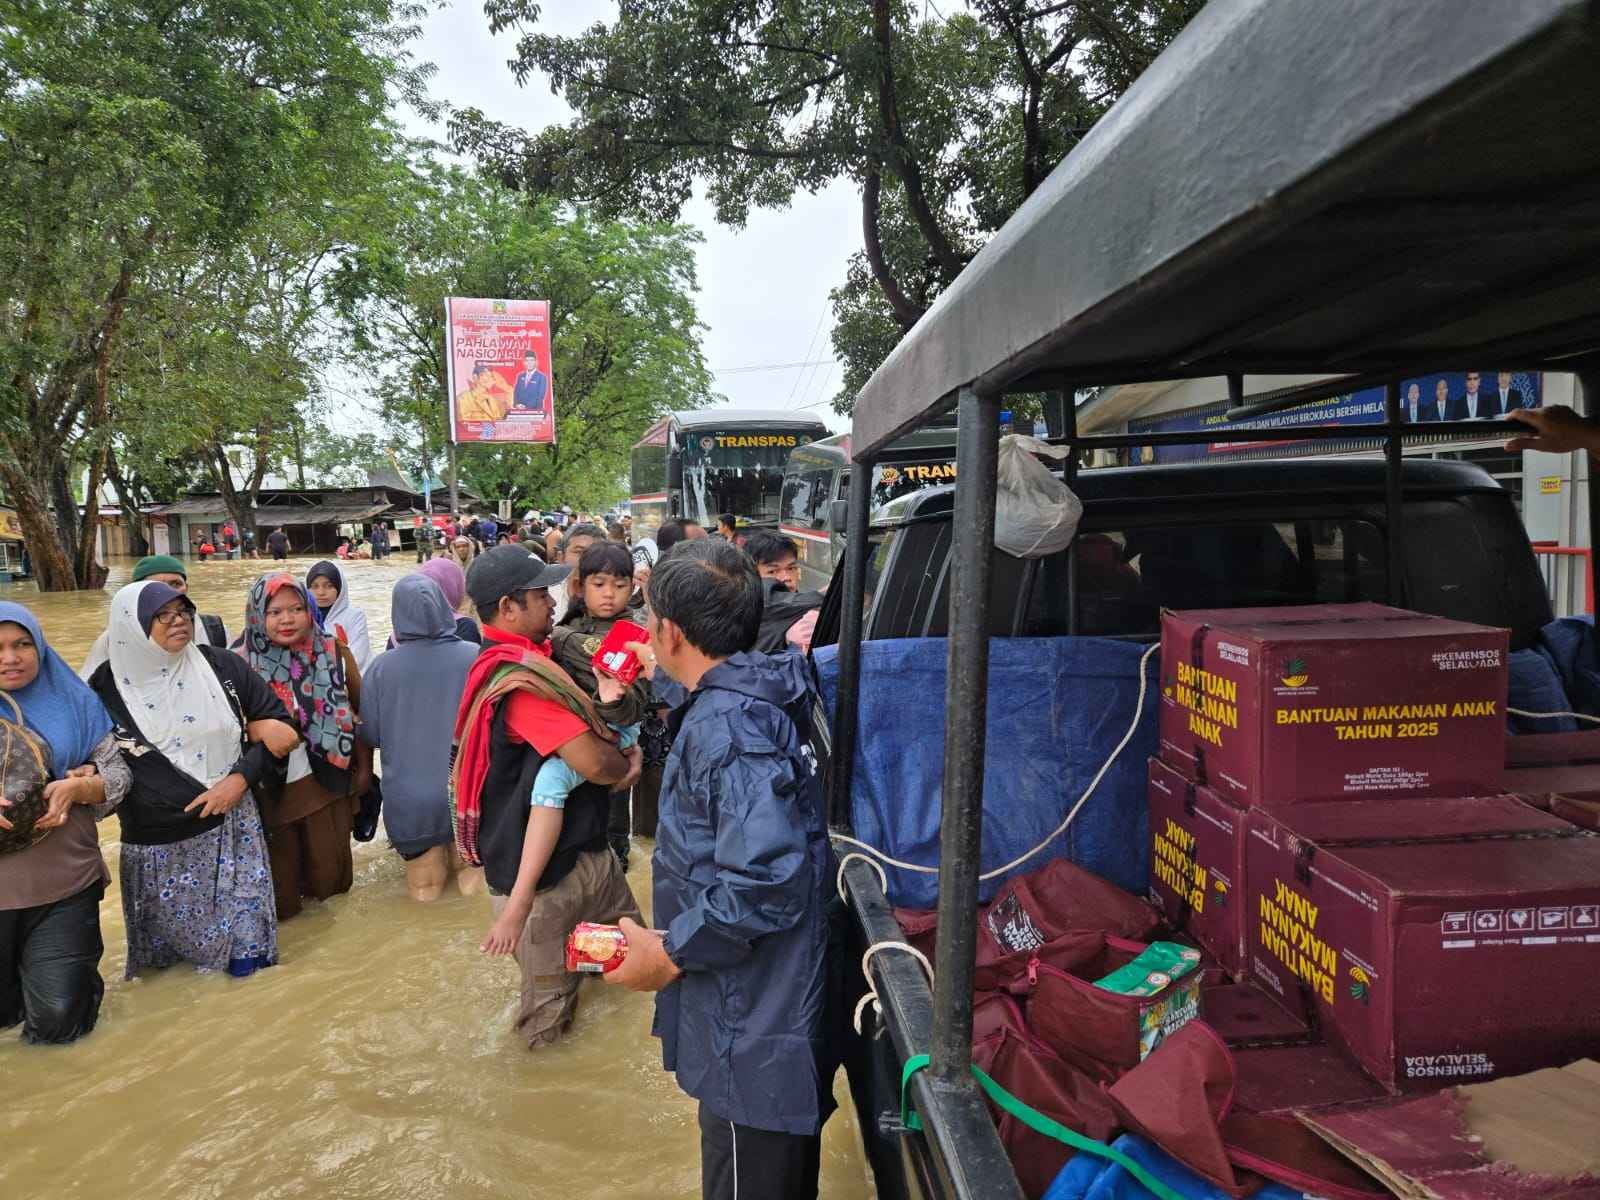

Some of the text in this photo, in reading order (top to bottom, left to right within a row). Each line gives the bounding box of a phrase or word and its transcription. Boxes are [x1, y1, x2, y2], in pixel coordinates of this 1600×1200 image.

[456, 337, 531, 350] PAHLAWAN
[456, 348, 522, 361] NASIONAL
[1271, 414, 1299, 427] WILAYAH
[1300, 410, 1334, 423] BIROKRASI
[1336, 405, 1362, 418] BERSIH
[718, 436, 796, 448] TRANSPAS
[1432, 648, 1500, 664] #KEMENSOS
[1178, 664, 1237, 704] BANTUAN
[1177, 684, 1238, 729] MAKANAN
[1276, 700, 1496, 725] BANTUAN MAKANAN ANAK
[1189, 714, 1222, 746] ANAK
[1335, 721, 1439, 740] TAHUN 2025
[1165, 818, 1195, 850] ANAK
[1274, 879, 1319, 930] ANAK
[1260, 894, 1338, 978] MAKANAN
[1260, 922, 1336, 1005] BANTUAN
[1407, 1061, 1496, 1078] #KEMENSOS
